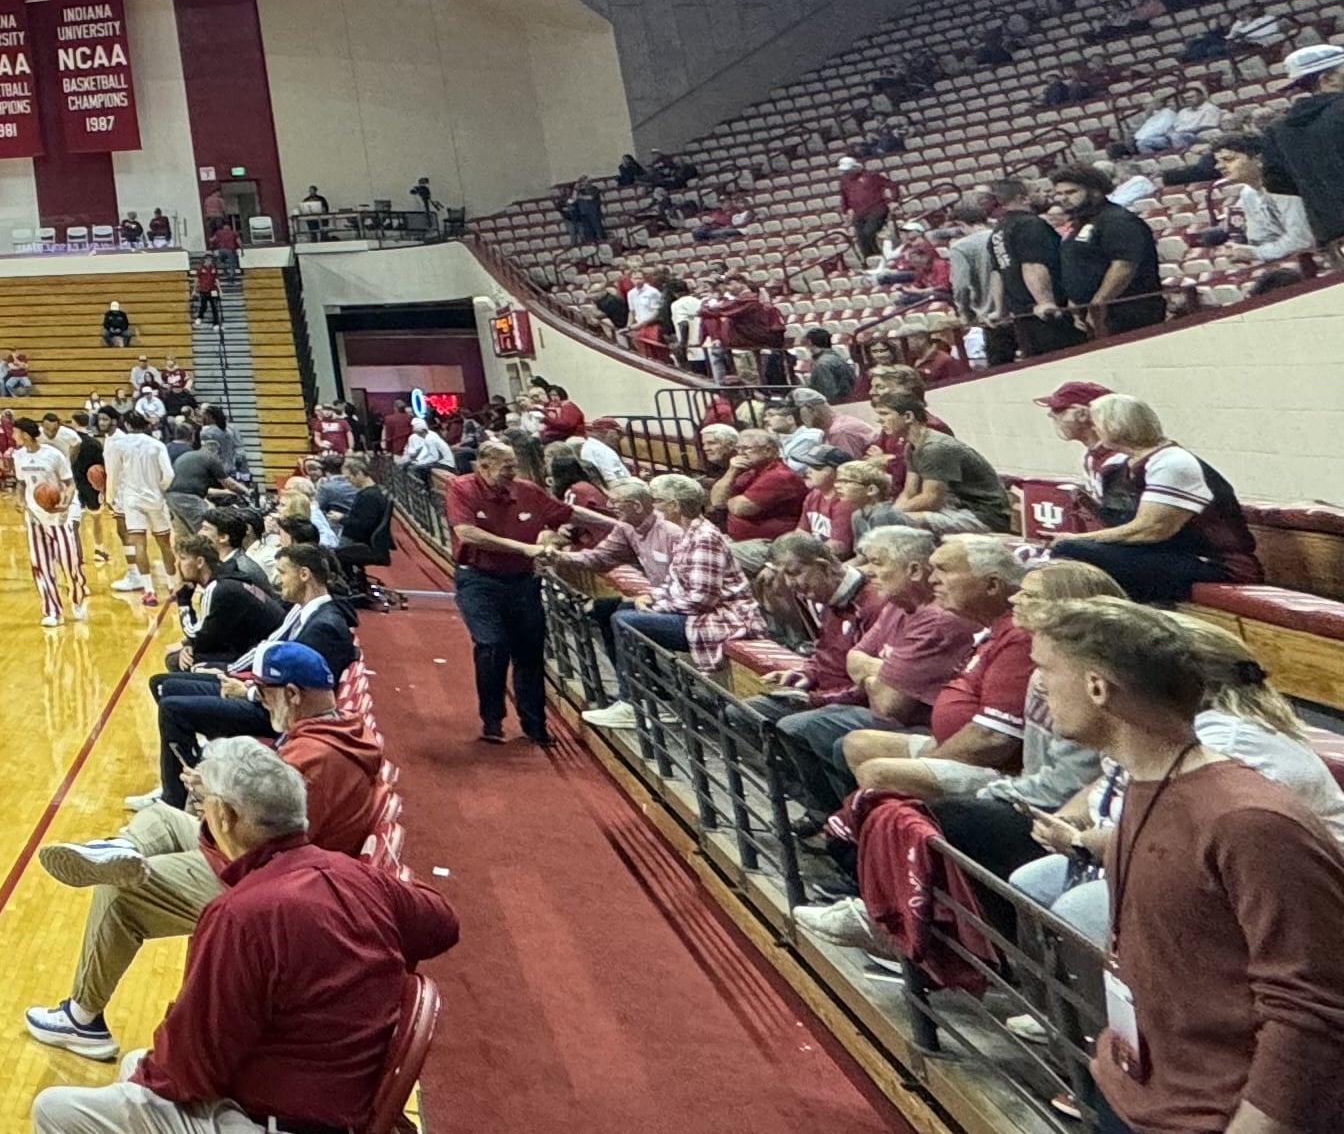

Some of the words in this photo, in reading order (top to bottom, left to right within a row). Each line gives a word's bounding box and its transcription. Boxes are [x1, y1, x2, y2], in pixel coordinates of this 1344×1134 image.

[62, 3, 112, 23] INDIANA
[57, 21, 121, 41] UNIVERSITY
[58, 43, 127, 71] NCAA
[62, 73, 128, 93] BASKETBALL
[67, 92, 128, 111] CHAMPIONS
[85, 115, 115, 132] 1987
